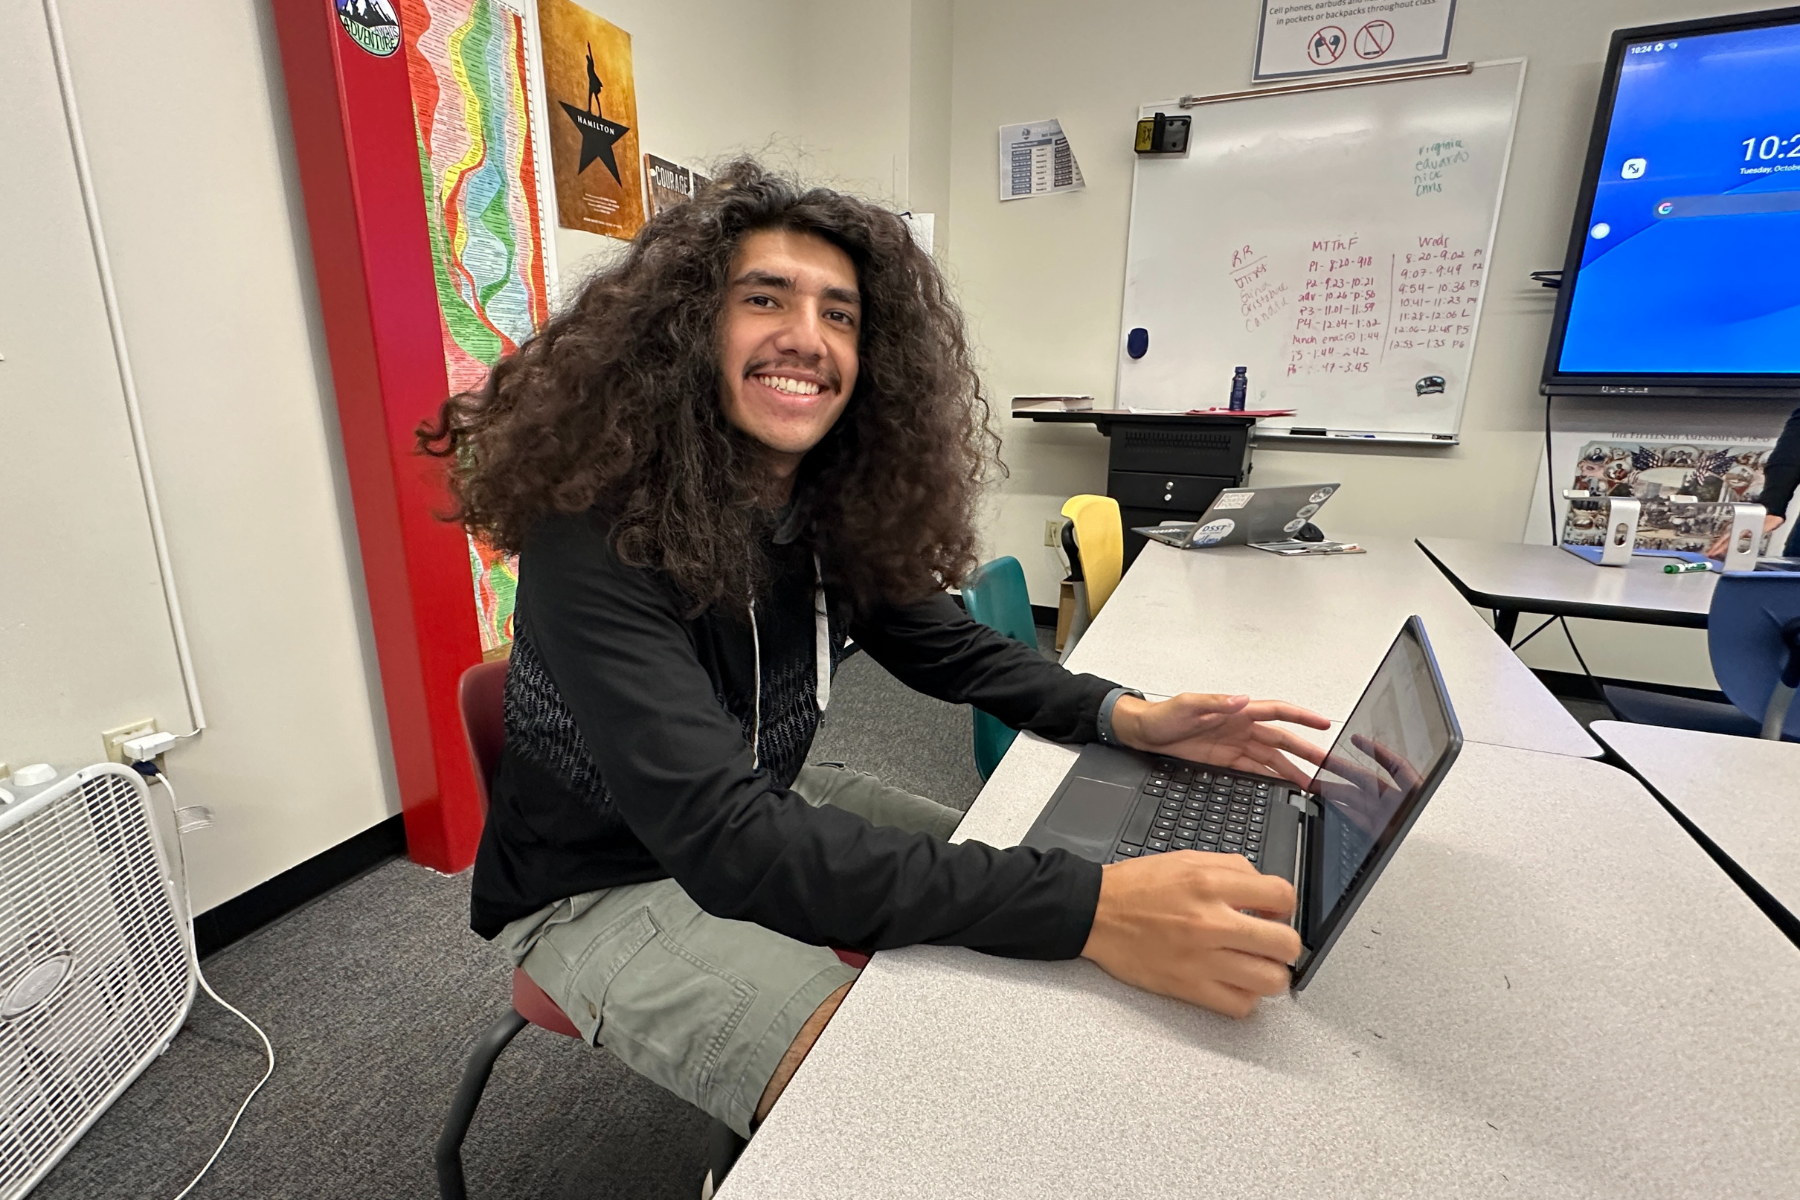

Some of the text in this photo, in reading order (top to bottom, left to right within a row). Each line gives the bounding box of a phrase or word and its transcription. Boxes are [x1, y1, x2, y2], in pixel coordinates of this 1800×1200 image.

[1269, 7, 1283, 15] Cell
[1284, 4, 1314, 15] phones,
[1315, 0, 1347, 9] earbuds
[1285, 14, 1315, 26] pockets
[1325, 7, 1366, 19] backpacks
[1367, 0, 1414, 14] throughout
[342, 17, 396, 51] ADVENTURE
[1631, 45, 1652, 54] 10:24
[577, 114, 615, 136] HAMILTON
[655, 165, 689, 196] COURAGE
